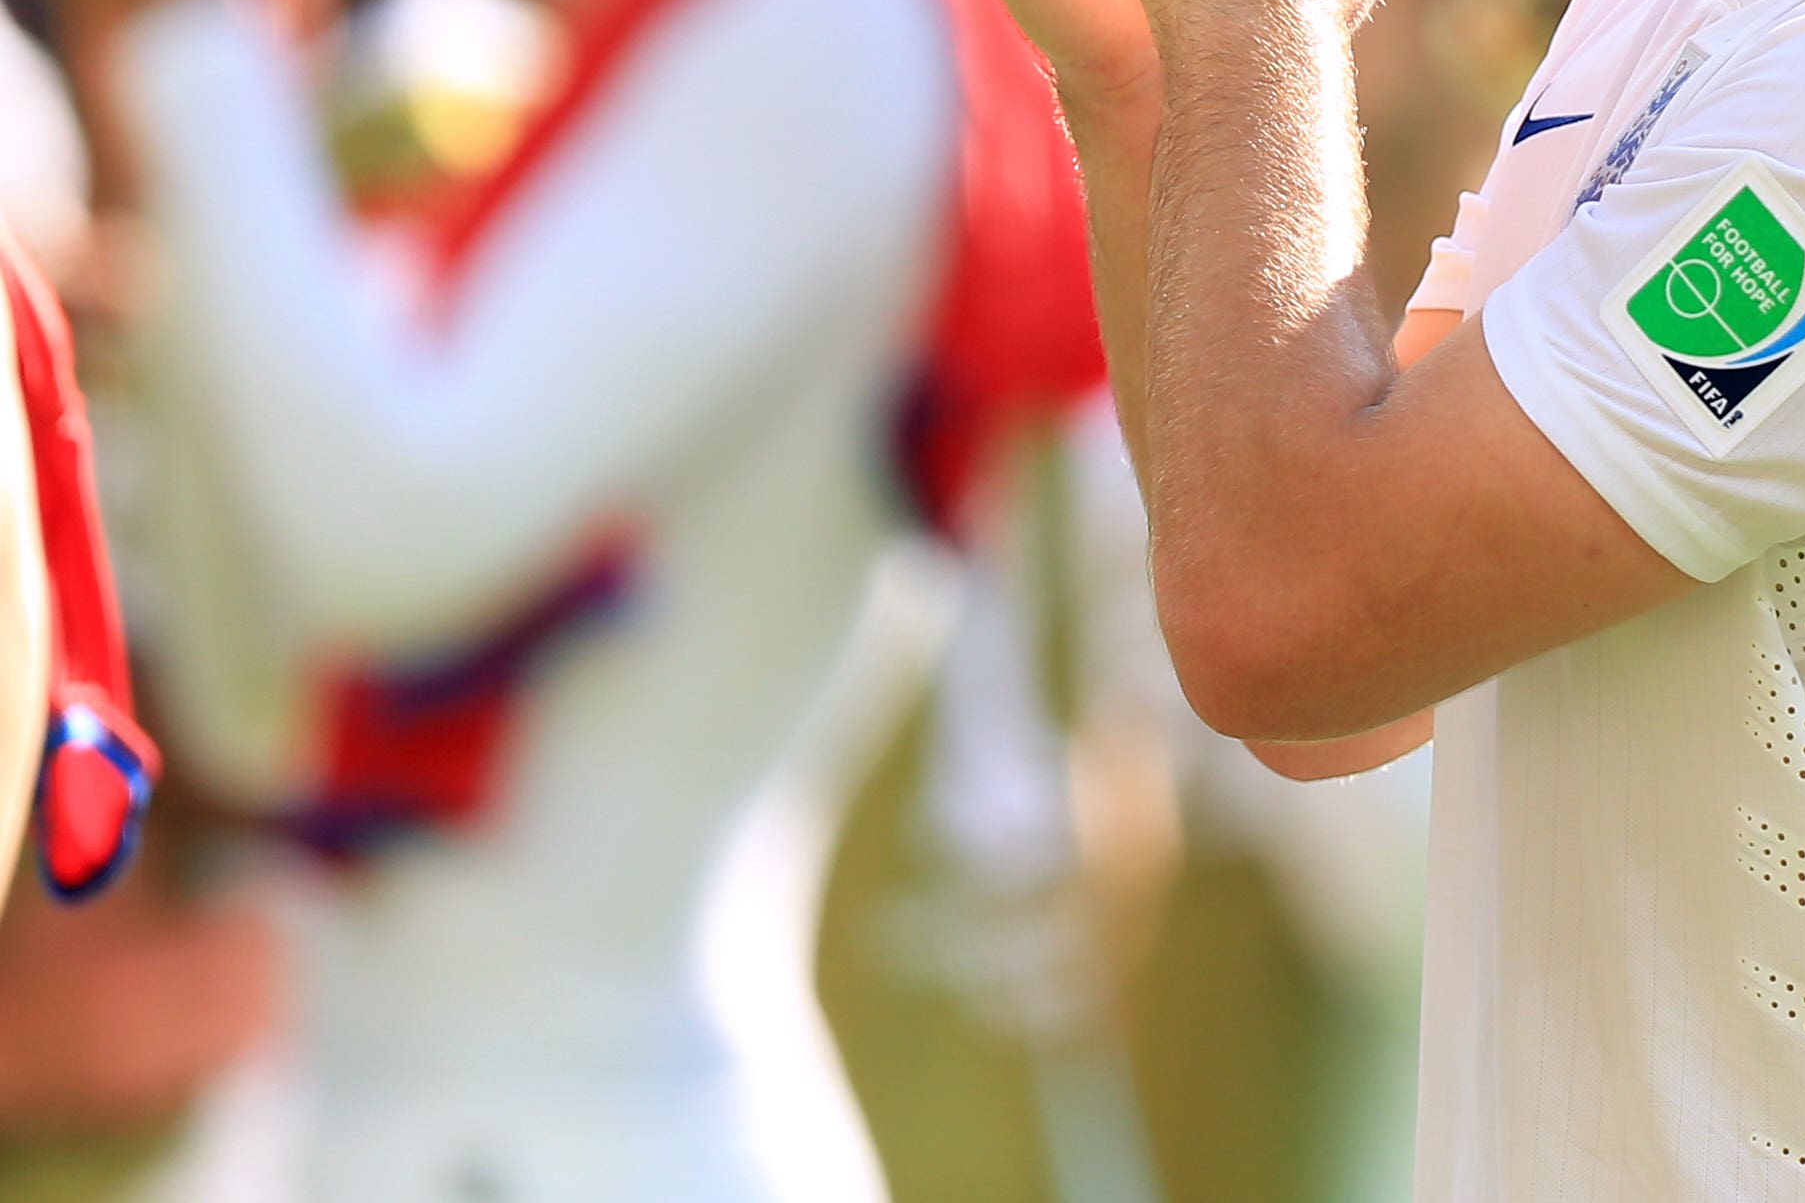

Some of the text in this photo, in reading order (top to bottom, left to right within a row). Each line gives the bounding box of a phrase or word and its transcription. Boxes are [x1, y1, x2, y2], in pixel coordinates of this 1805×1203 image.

[1701, 231, 1776, 314] FOR HOPE
[1715, 218, 1792, 305] FOOTBALL
[1688, 371, 1728, 415] FIFA
